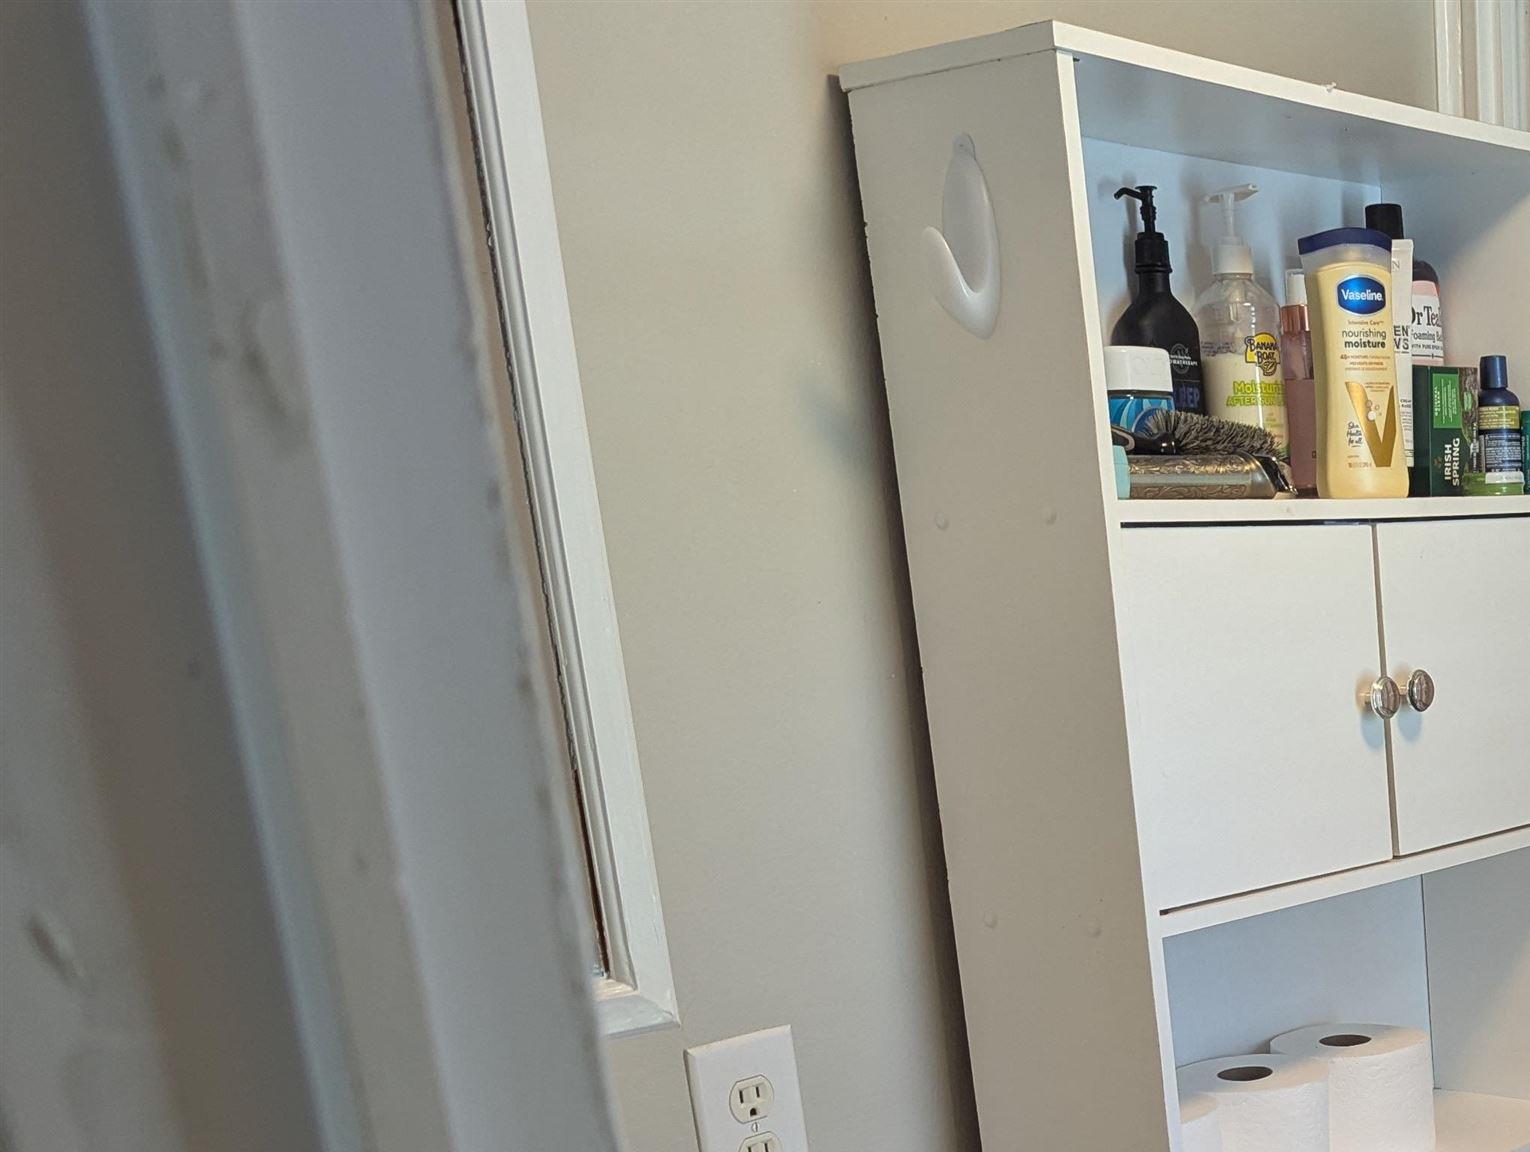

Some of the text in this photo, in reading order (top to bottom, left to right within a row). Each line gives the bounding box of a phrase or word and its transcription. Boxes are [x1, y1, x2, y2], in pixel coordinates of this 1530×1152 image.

[1341, 289, 1384, 301] Vaseline
[1342, 328, 1387, 340] nourishing
[1345, 339, 1386, 348] moisture
[1444, 444, 1452, 480] IRISH
[1452, 437, 1460, 486] SPRING
